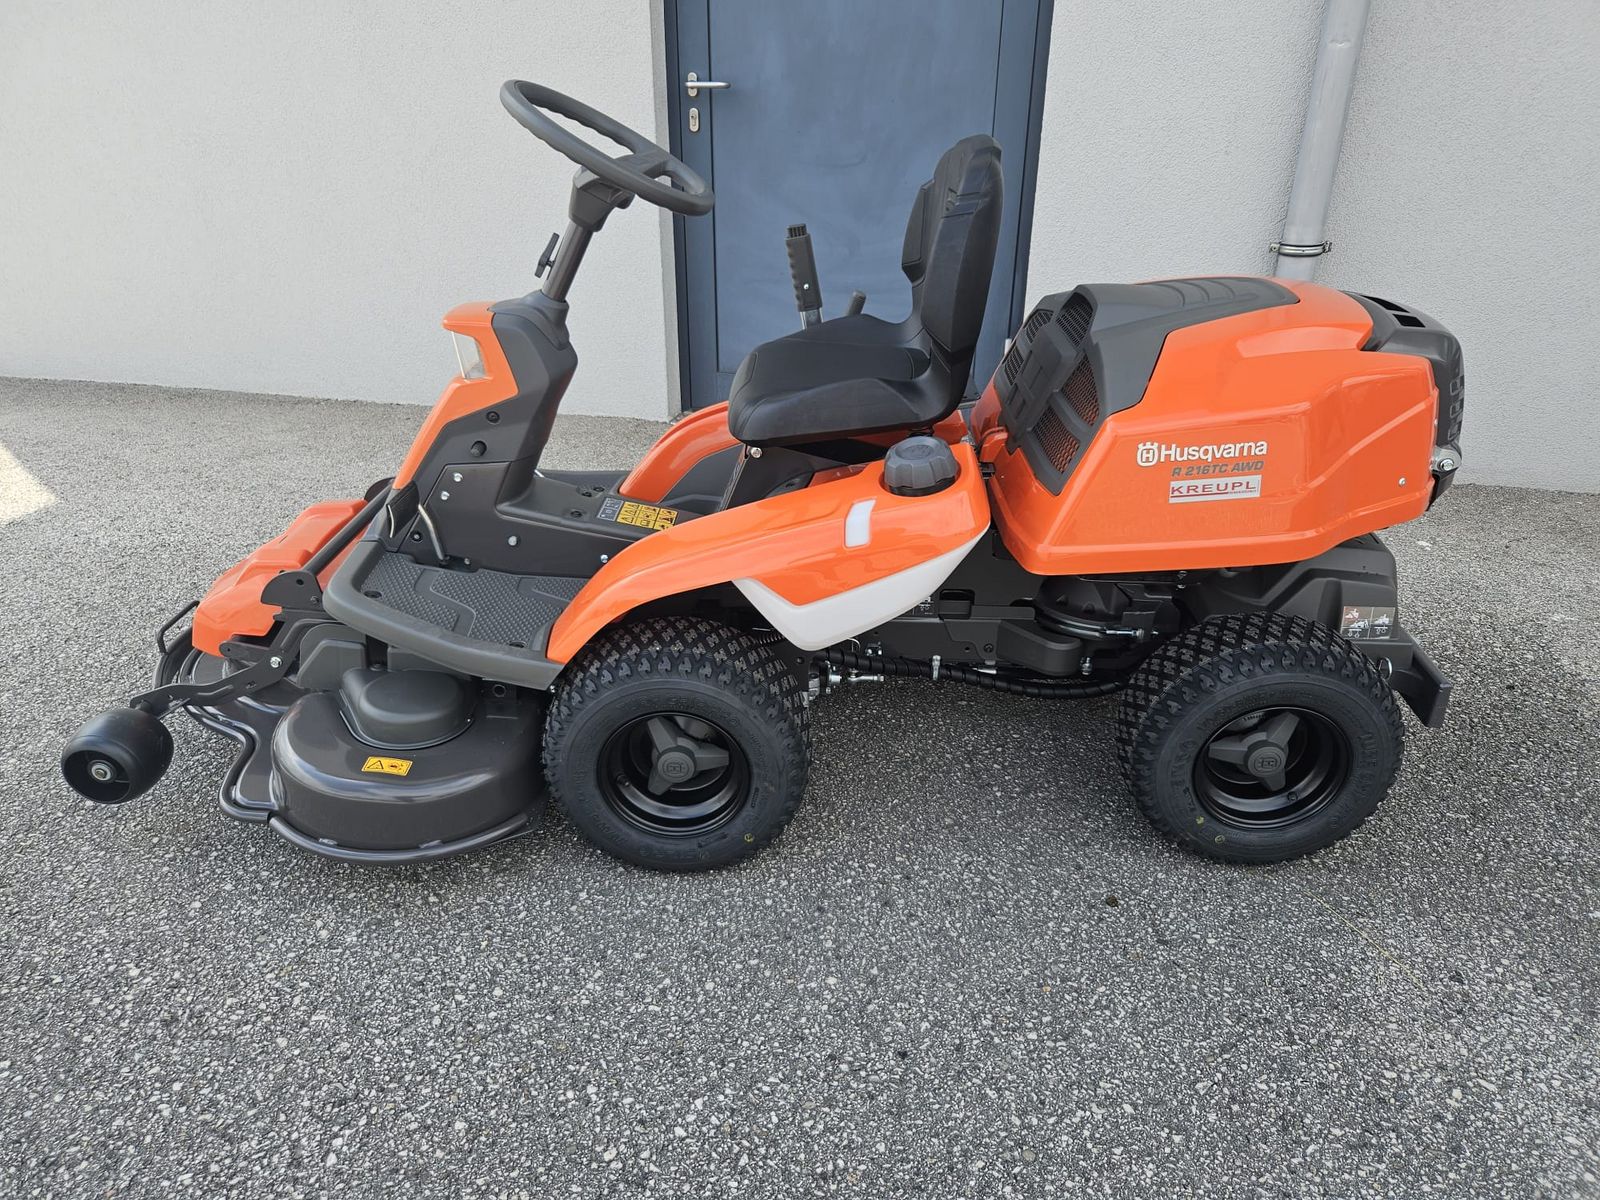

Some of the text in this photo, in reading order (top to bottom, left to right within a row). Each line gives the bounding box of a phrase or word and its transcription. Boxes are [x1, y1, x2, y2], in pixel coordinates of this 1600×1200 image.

[1160, 441, 1267, 462] Husqvarna
[1172, 460, 1264, 477] R 216TC AWD
[1171, 481, 1257, 495] KREUPL
